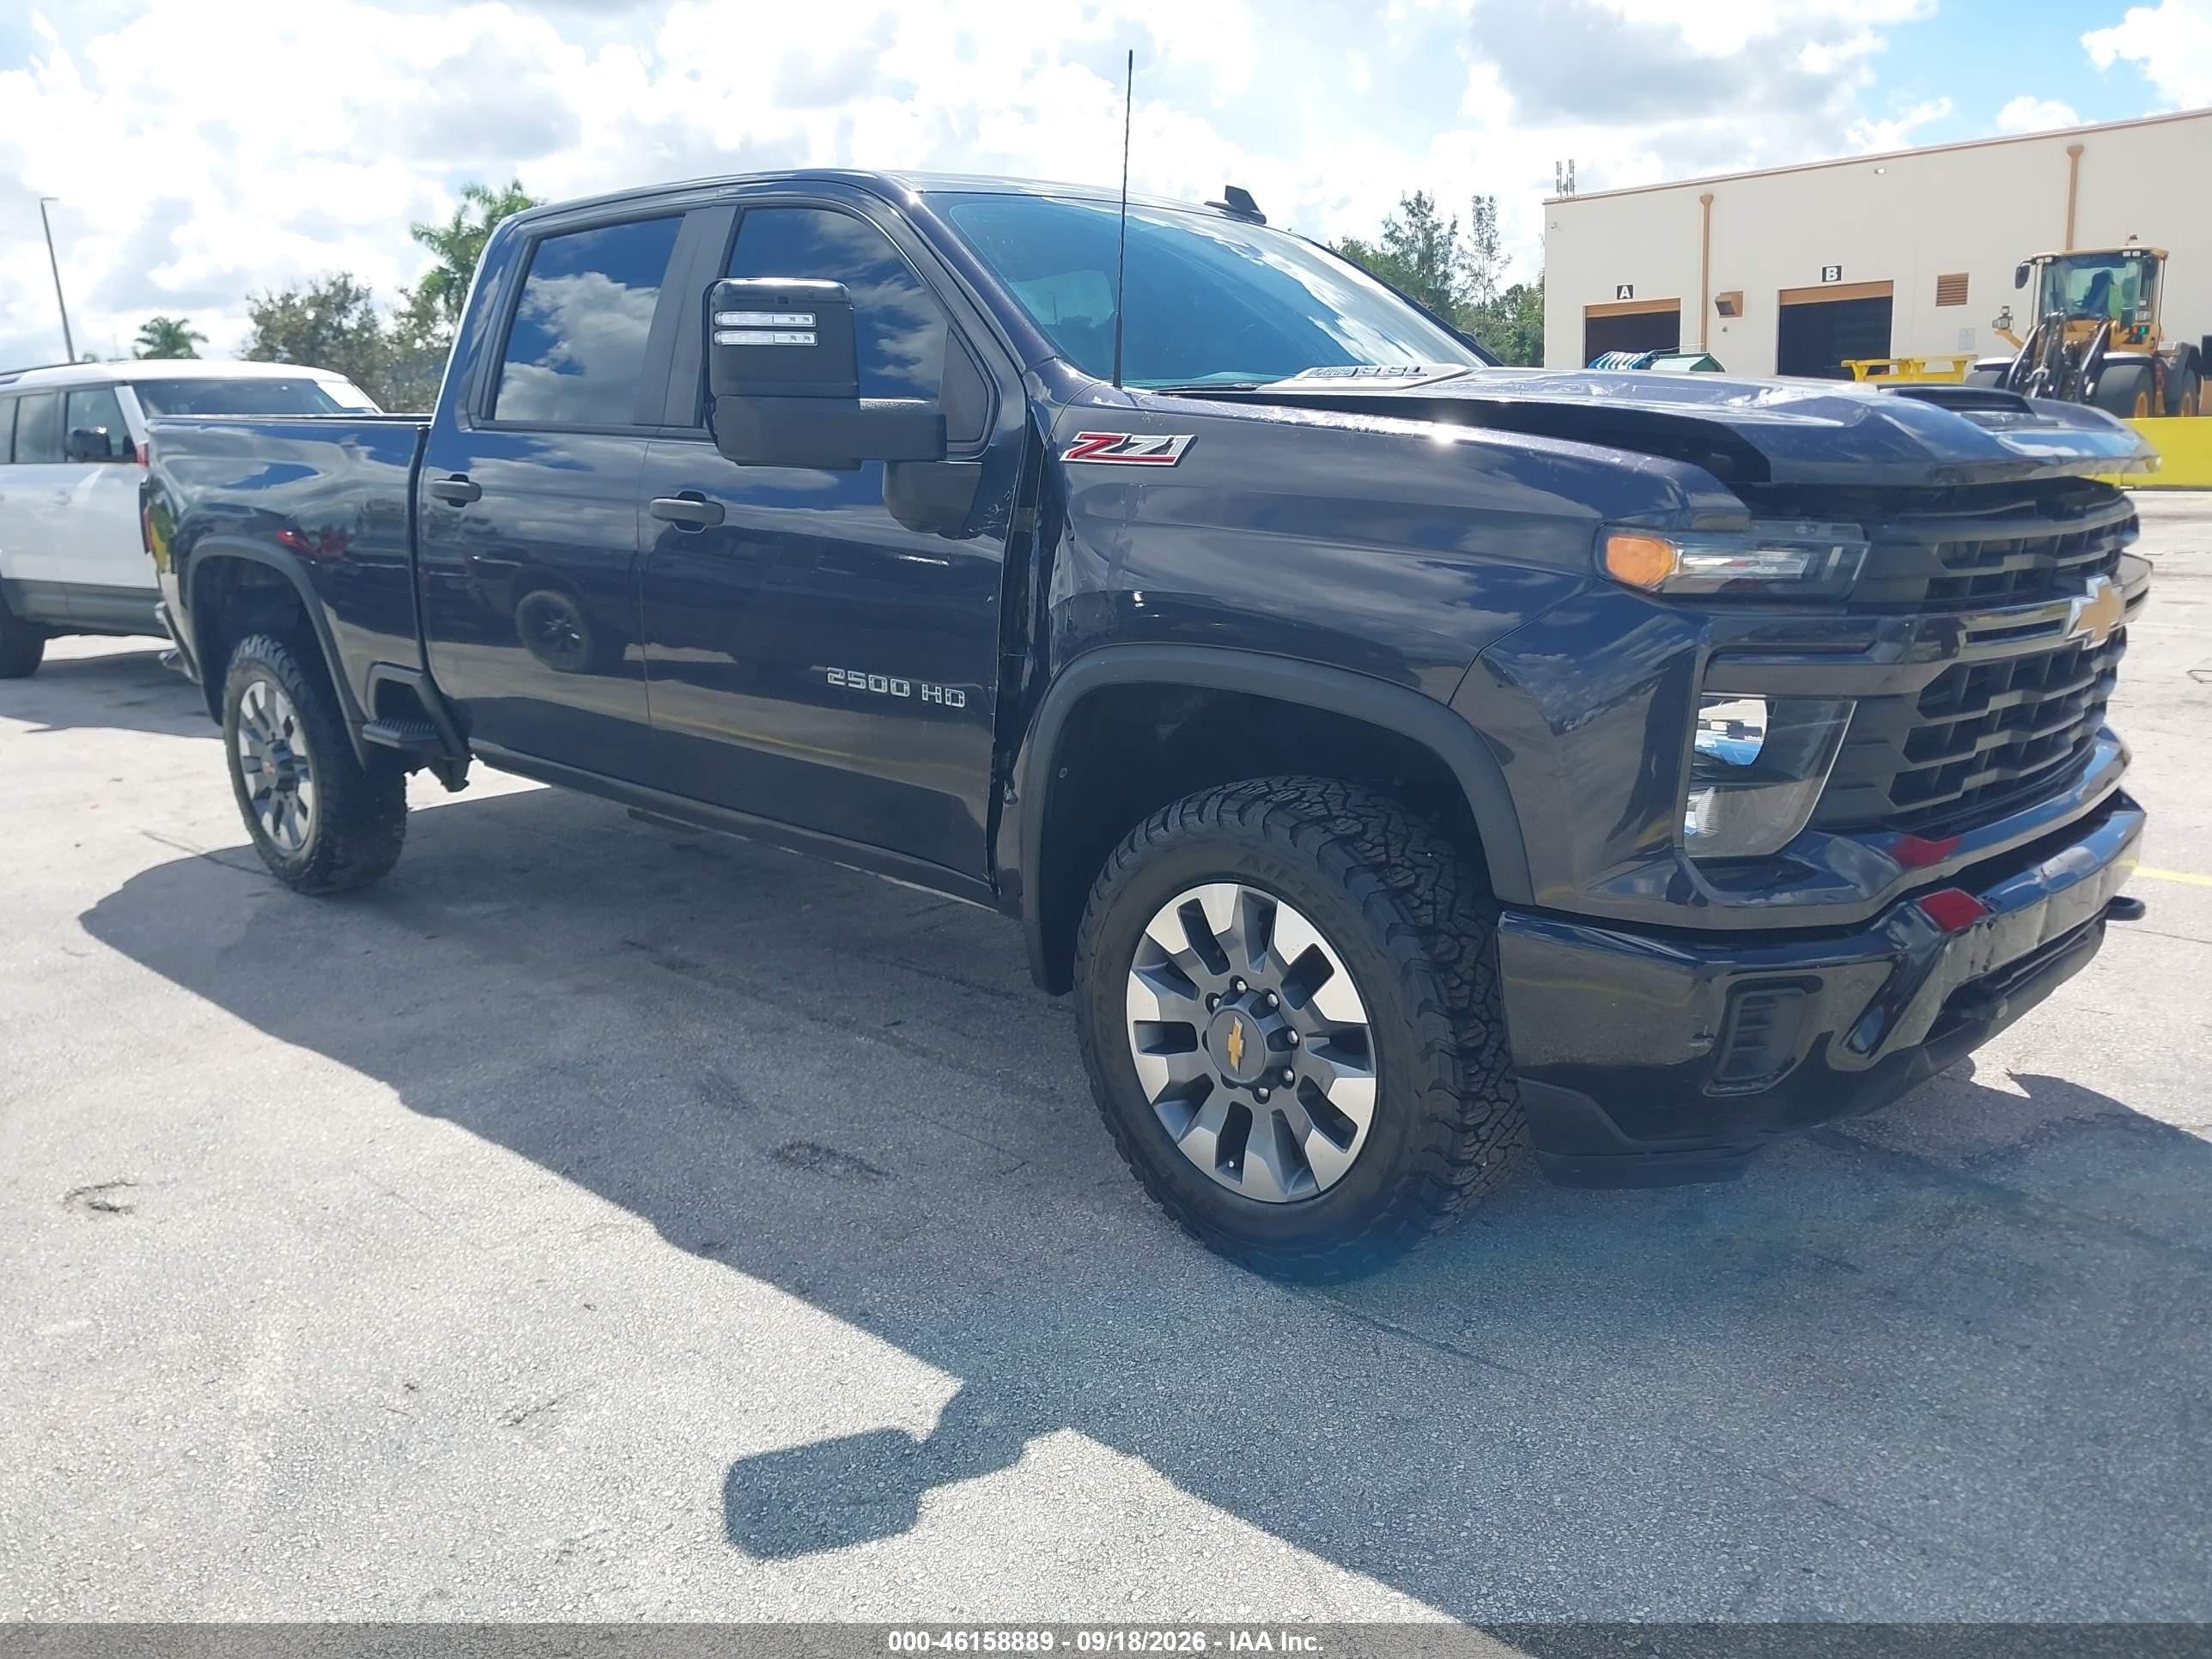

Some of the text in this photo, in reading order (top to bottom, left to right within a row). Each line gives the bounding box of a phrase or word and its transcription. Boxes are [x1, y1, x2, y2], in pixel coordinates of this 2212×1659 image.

[1826, 266, 1838, 282] B
[1618, 284, 1632, 299] A
[1059, 430, 1195, 467] Z71
[826, 666, 965, 708] 2500 HD
